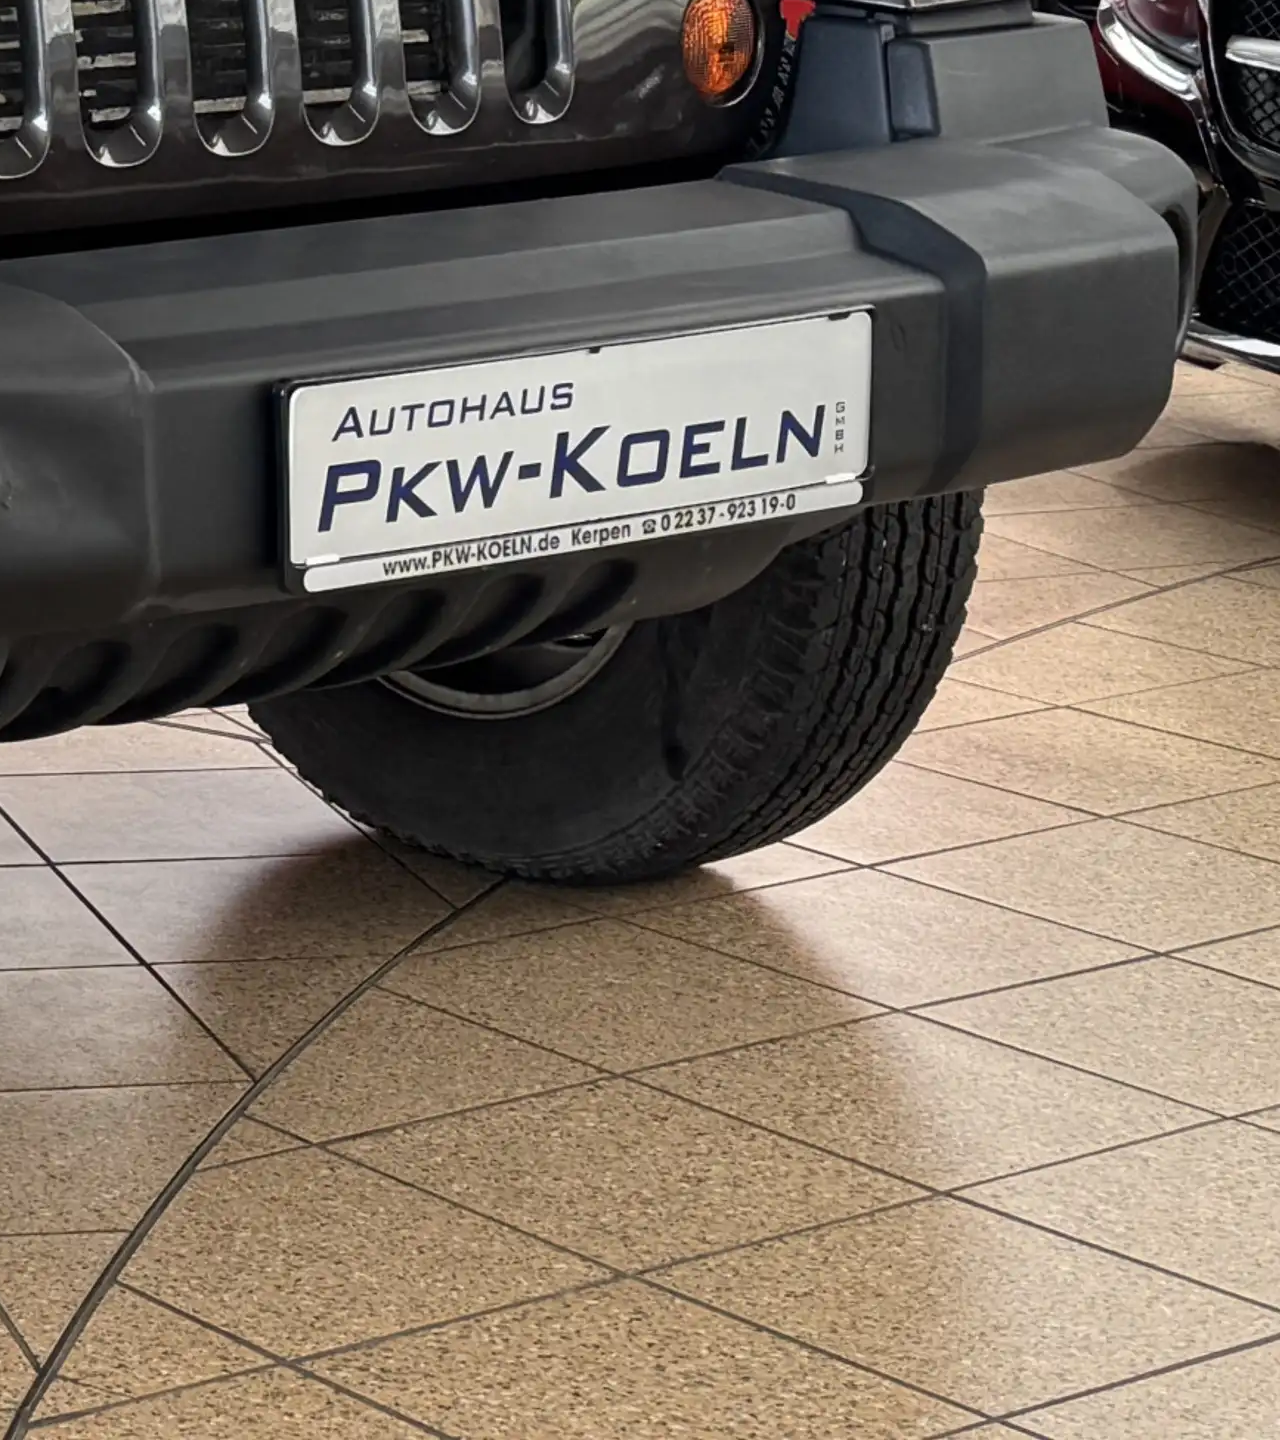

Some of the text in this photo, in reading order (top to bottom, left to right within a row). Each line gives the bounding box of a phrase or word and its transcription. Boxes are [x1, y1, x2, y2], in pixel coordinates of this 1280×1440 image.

[331, 382, 573, 442] AUTOHAUS
[317, 404, 826, 533] PKW-KOELN
[382, 531, 561, 576] www.PKW-KOELN.de
[571, 523, 632, 547] Kerpen
